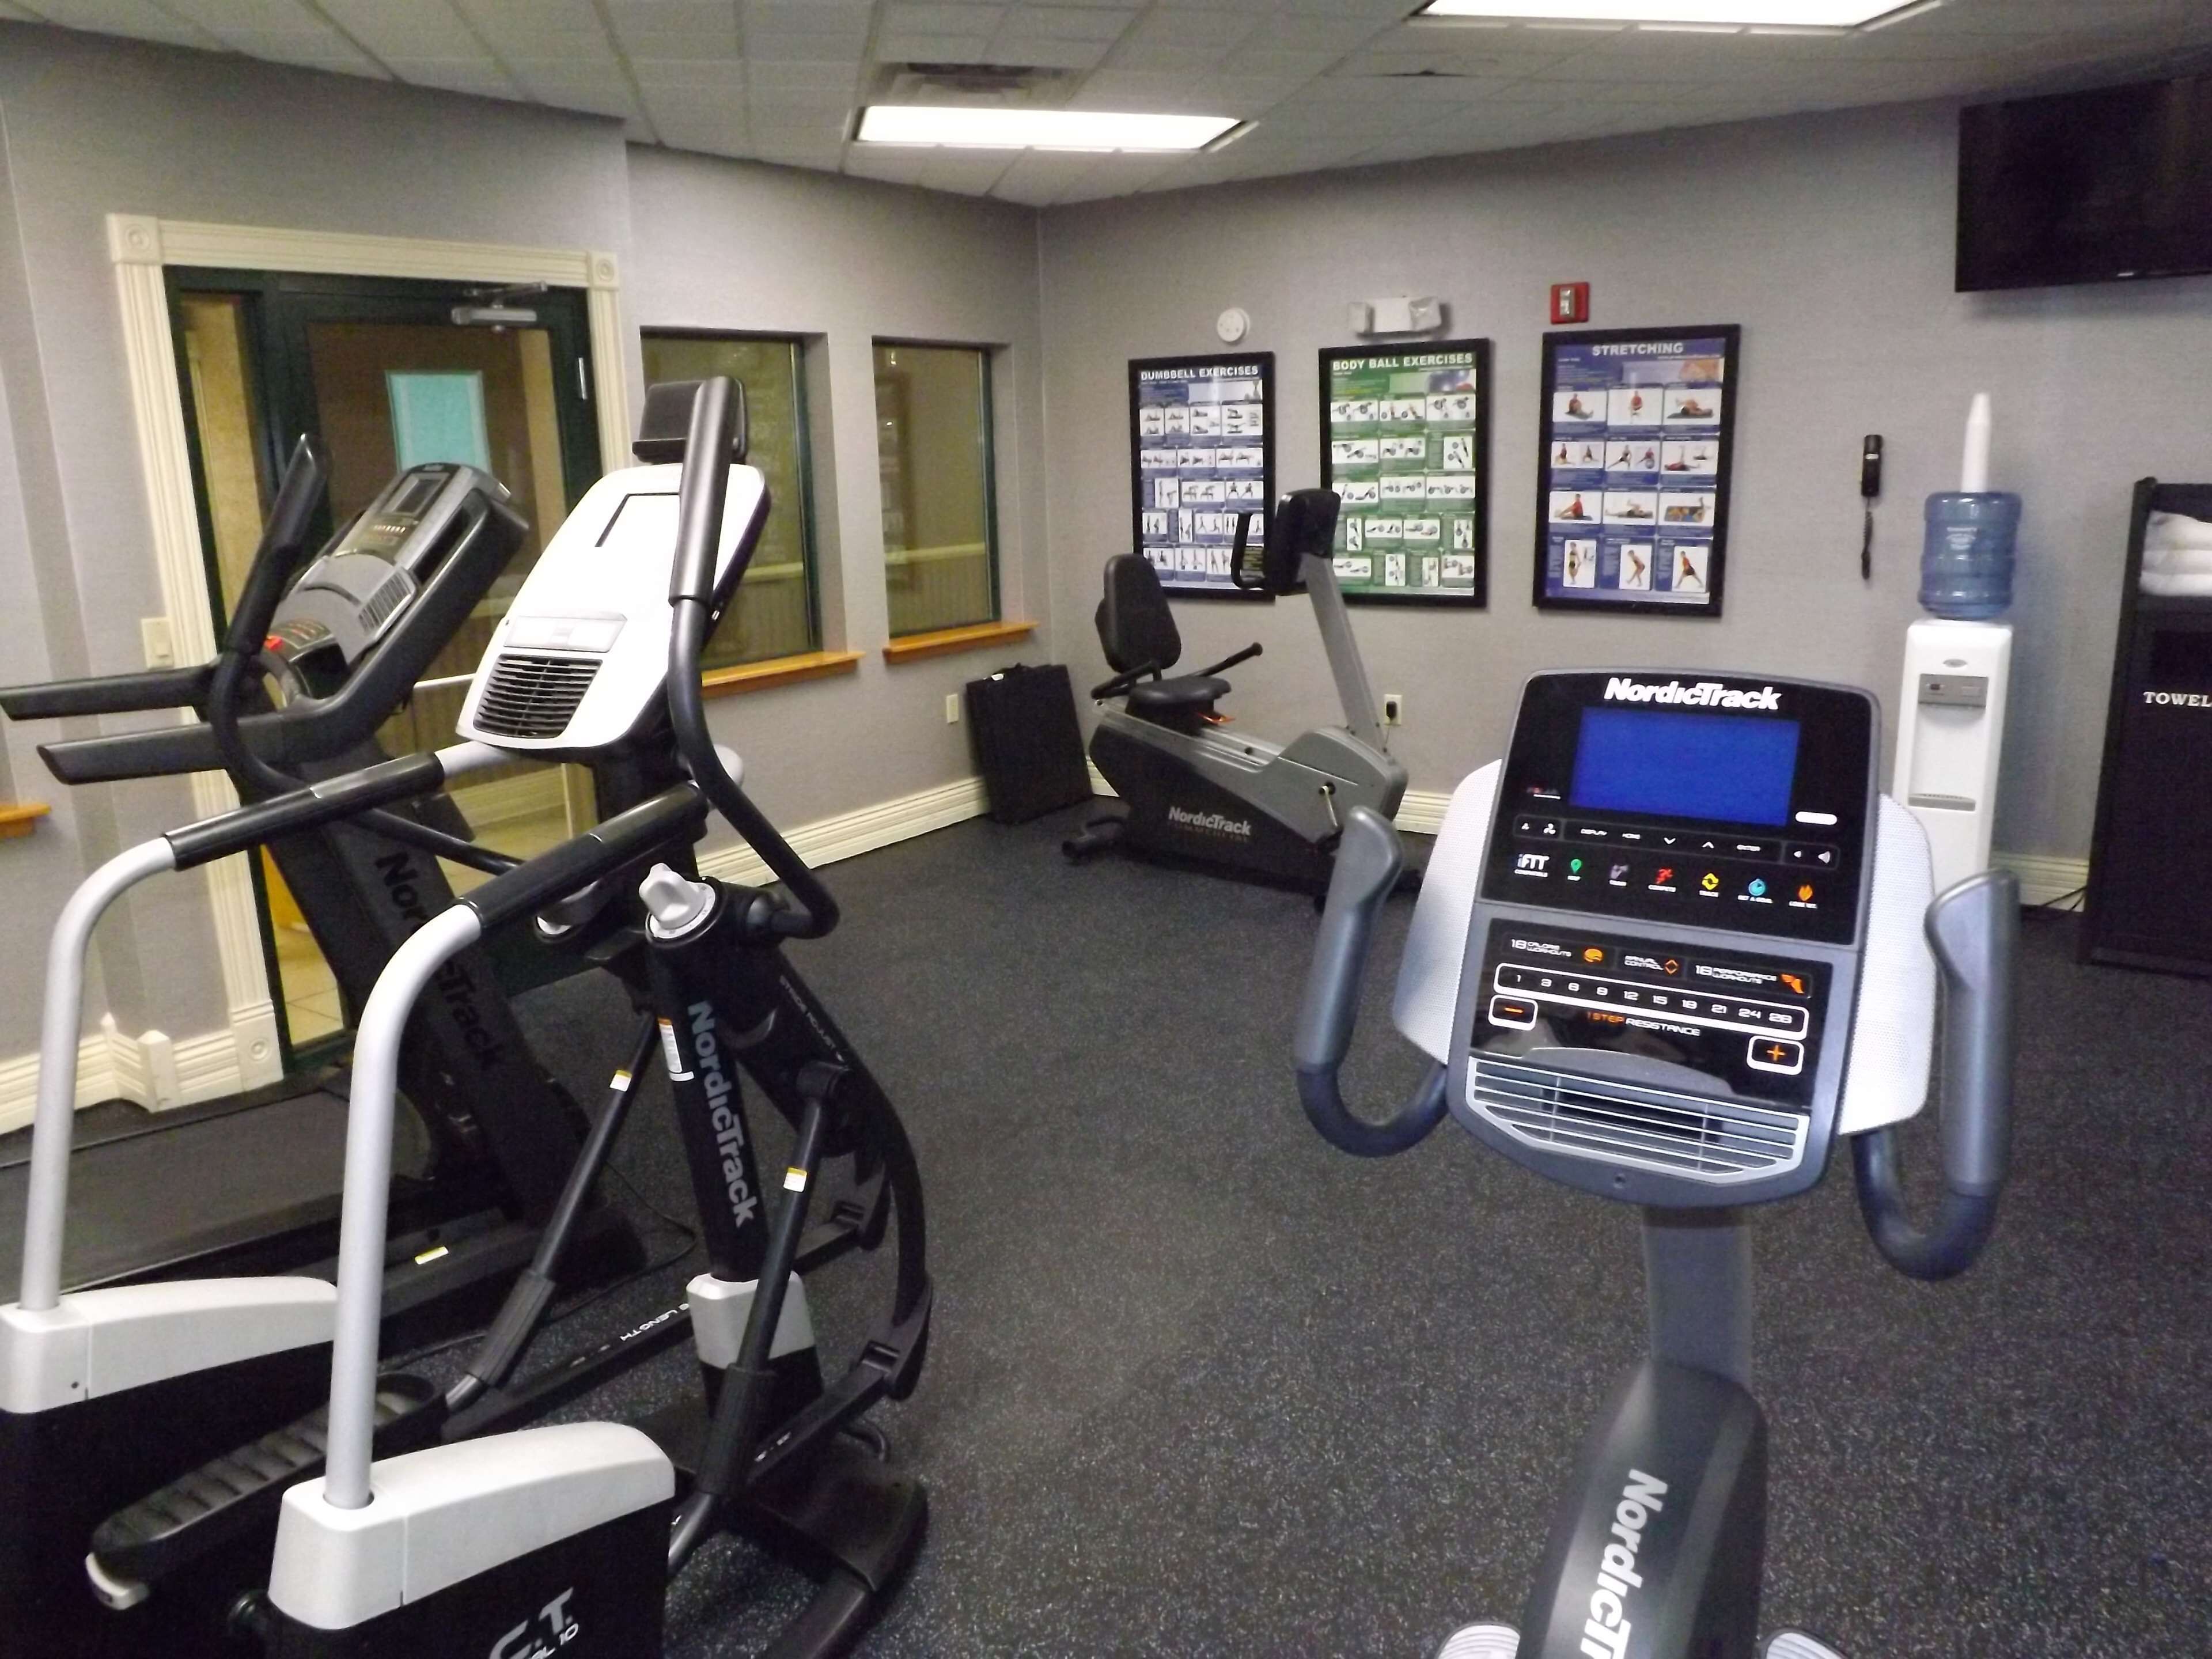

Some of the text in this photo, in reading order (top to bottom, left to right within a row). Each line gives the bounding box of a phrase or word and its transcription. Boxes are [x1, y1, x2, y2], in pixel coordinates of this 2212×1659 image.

[1592, 343, 1684, 357] STRETCHING
[1332, 353, 1472, 371] BODY BALL EXERCISES
[1141, 369, 1196, 381] DUMBBELL
[1199, 365, 1259, 378] EXERCISES
[1604, 677, 1782, 710] NordicTrack
[2143, 691, 2212, 707] TOWEL
[1169, 806, 1251, 835] NordicTrack
[1512, 939, 1527, 950] 18
[1695, 965, 1713, 977] 18
[1516, 974, 1521, 982] 1
[1540, 978, 1552, 987] 3
[1623, 990, 1639, 1001] 12
[1652, 995, 1668, 1005] 15
[1681, 999, 1698, 1010] 18
[1711, 1004, 1728, 1014] 21
[1738, 1008, 1762, 1019] 24
[1625, 1017, 1701, 1036] RESISTANCE
[687, 1001, 759, 1228] NordicTrack
